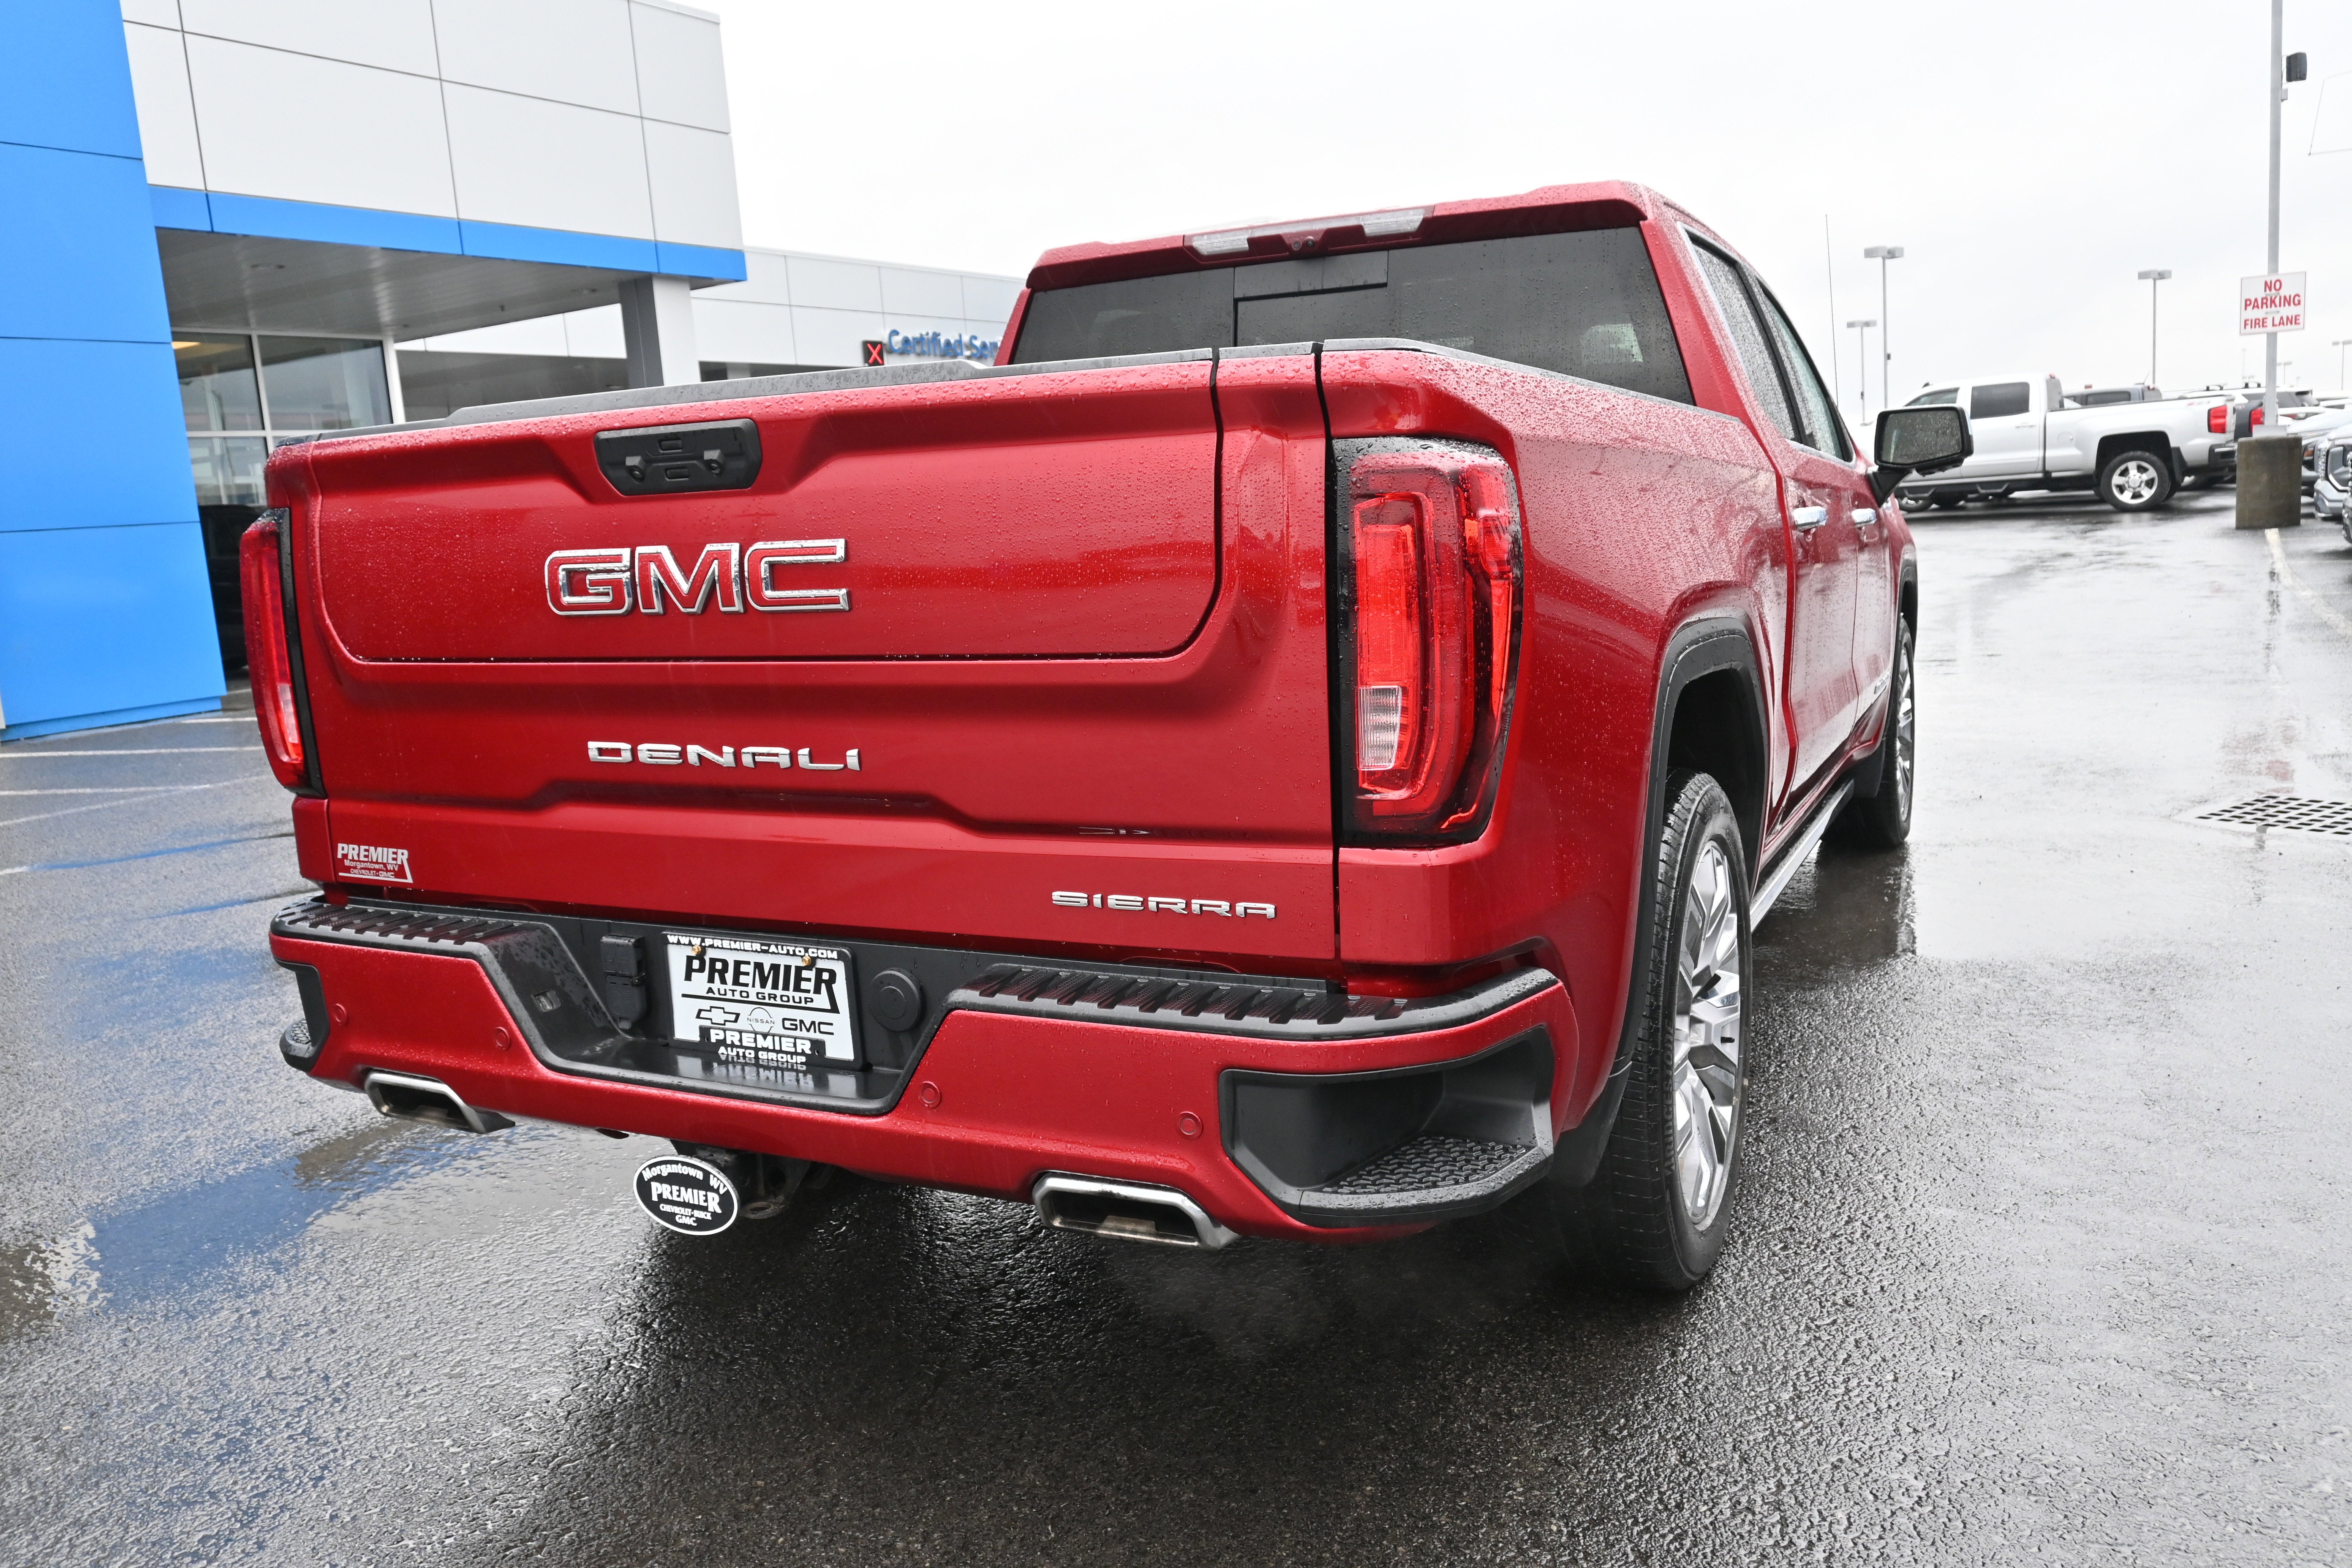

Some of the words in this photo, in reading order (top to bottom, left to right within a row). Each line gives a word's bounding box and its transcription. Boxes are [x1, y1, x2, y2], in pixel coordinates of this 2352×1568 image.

[2264, 279, 2282, 292] NO
[2244, 294, 2301, 311] PARKING
[2243, 317, 2268, 329] FIRE
[2272, 314, 2300, 327] LANE
[889, 329, 964, 357] Certified
[544, 538, 851, 615] GMC
[588, 741, 860, 771] DENALI
[337, 843, 410, 868] PREMIER
[344, 859, 386, 871] Morgantown,
[1052, 891, 1277, 919] SIERRA
[667, 935, 838, 959] WWW.PREMIER-AUTO.COM
[684, 955, 839, 1002] PREMIER
[706, 987, 749, 999] AUTO
[756, 992, 814, 1005] GROUP
[747, 1017, 775, 1025] NISSAN
[782, 1018, 834, 1035] GMC
[710, 1029, 811, 1054] PREMIER
[718, 1046, 754, 1058] AUTO
[759, 1051, 806, 1063] GROUP
[642, 1163, 703, 1181] Morgantown
[710, 1174, 727, 1195] WV
[651, 1181, 722, 1213] PREMIER
[675, 1215, 697, 1226] GMC
